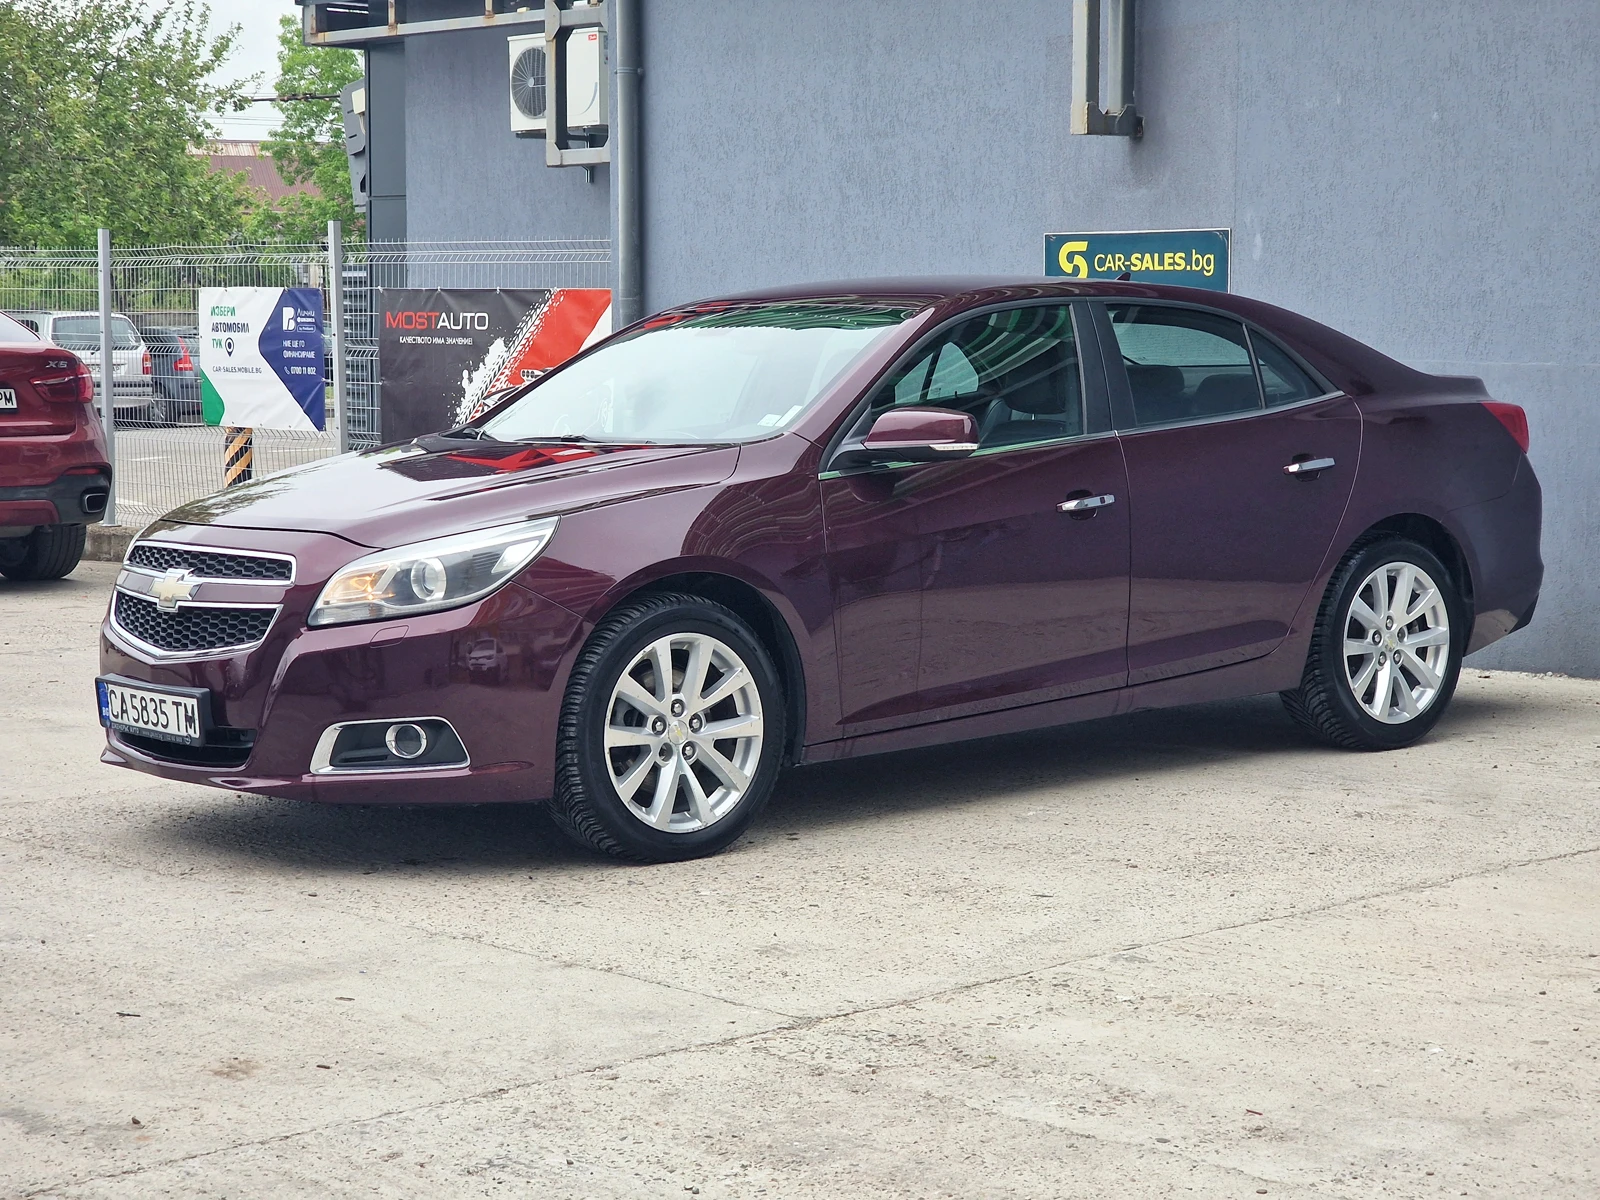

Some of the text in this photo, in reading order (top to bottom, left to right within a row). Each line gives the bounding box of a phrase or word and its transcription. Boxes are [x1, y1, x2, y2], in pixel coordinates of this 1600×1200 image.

[1094, 249, 1214, 276] CAR-SALES.bg
[211, 306, 235, 316] ИЗБЕРИ
[386, 311, 489, 330] MOSTAUTO
[211, 322, 250, 333] АВТОМОБИЛ
[212, 338, 223, 349] ТУК
[399, 336, 432, 344] КАЧЕСТВОТО
[283, 350, 315, 358] ФИНАНСИРАМЕ
[291, 366, 317, 375] 0700 11 802
[102, 707, 109, 716] BG
